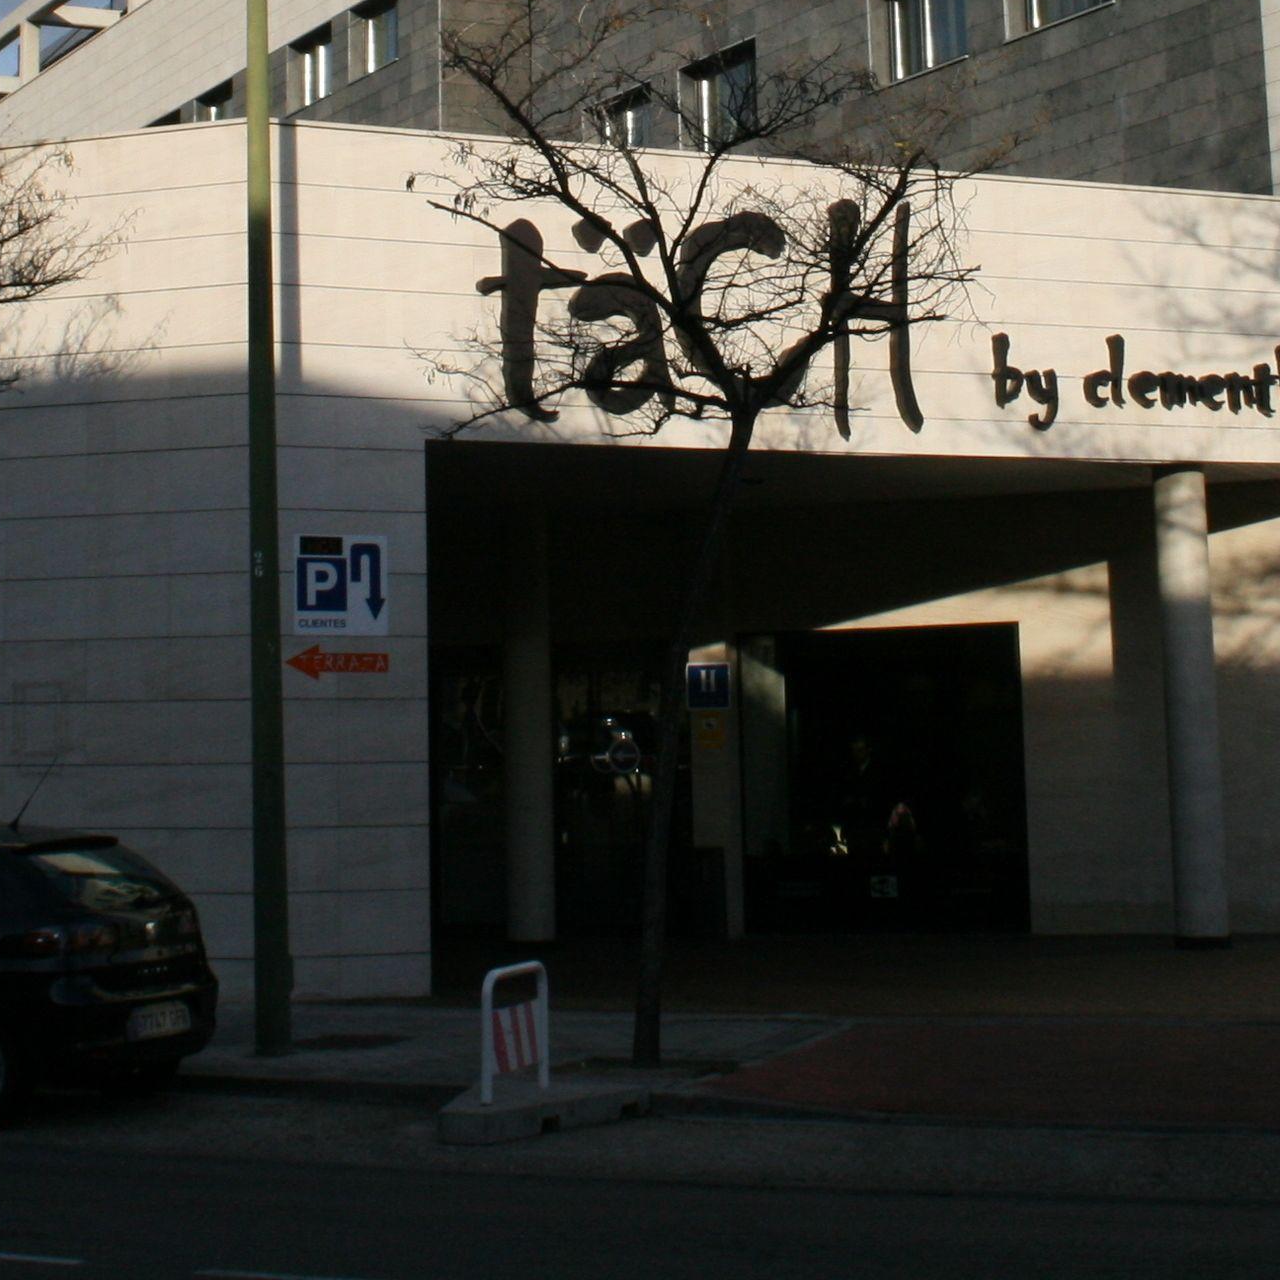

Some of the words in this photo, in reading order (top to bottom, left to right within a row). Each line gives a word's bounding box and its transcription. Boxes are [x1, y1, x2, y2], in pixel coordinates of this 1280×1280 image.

[991, 332, 1059, 431] by
[306, 561, 338, 606] P
[298, 619, 346, 628] CLIENTES
